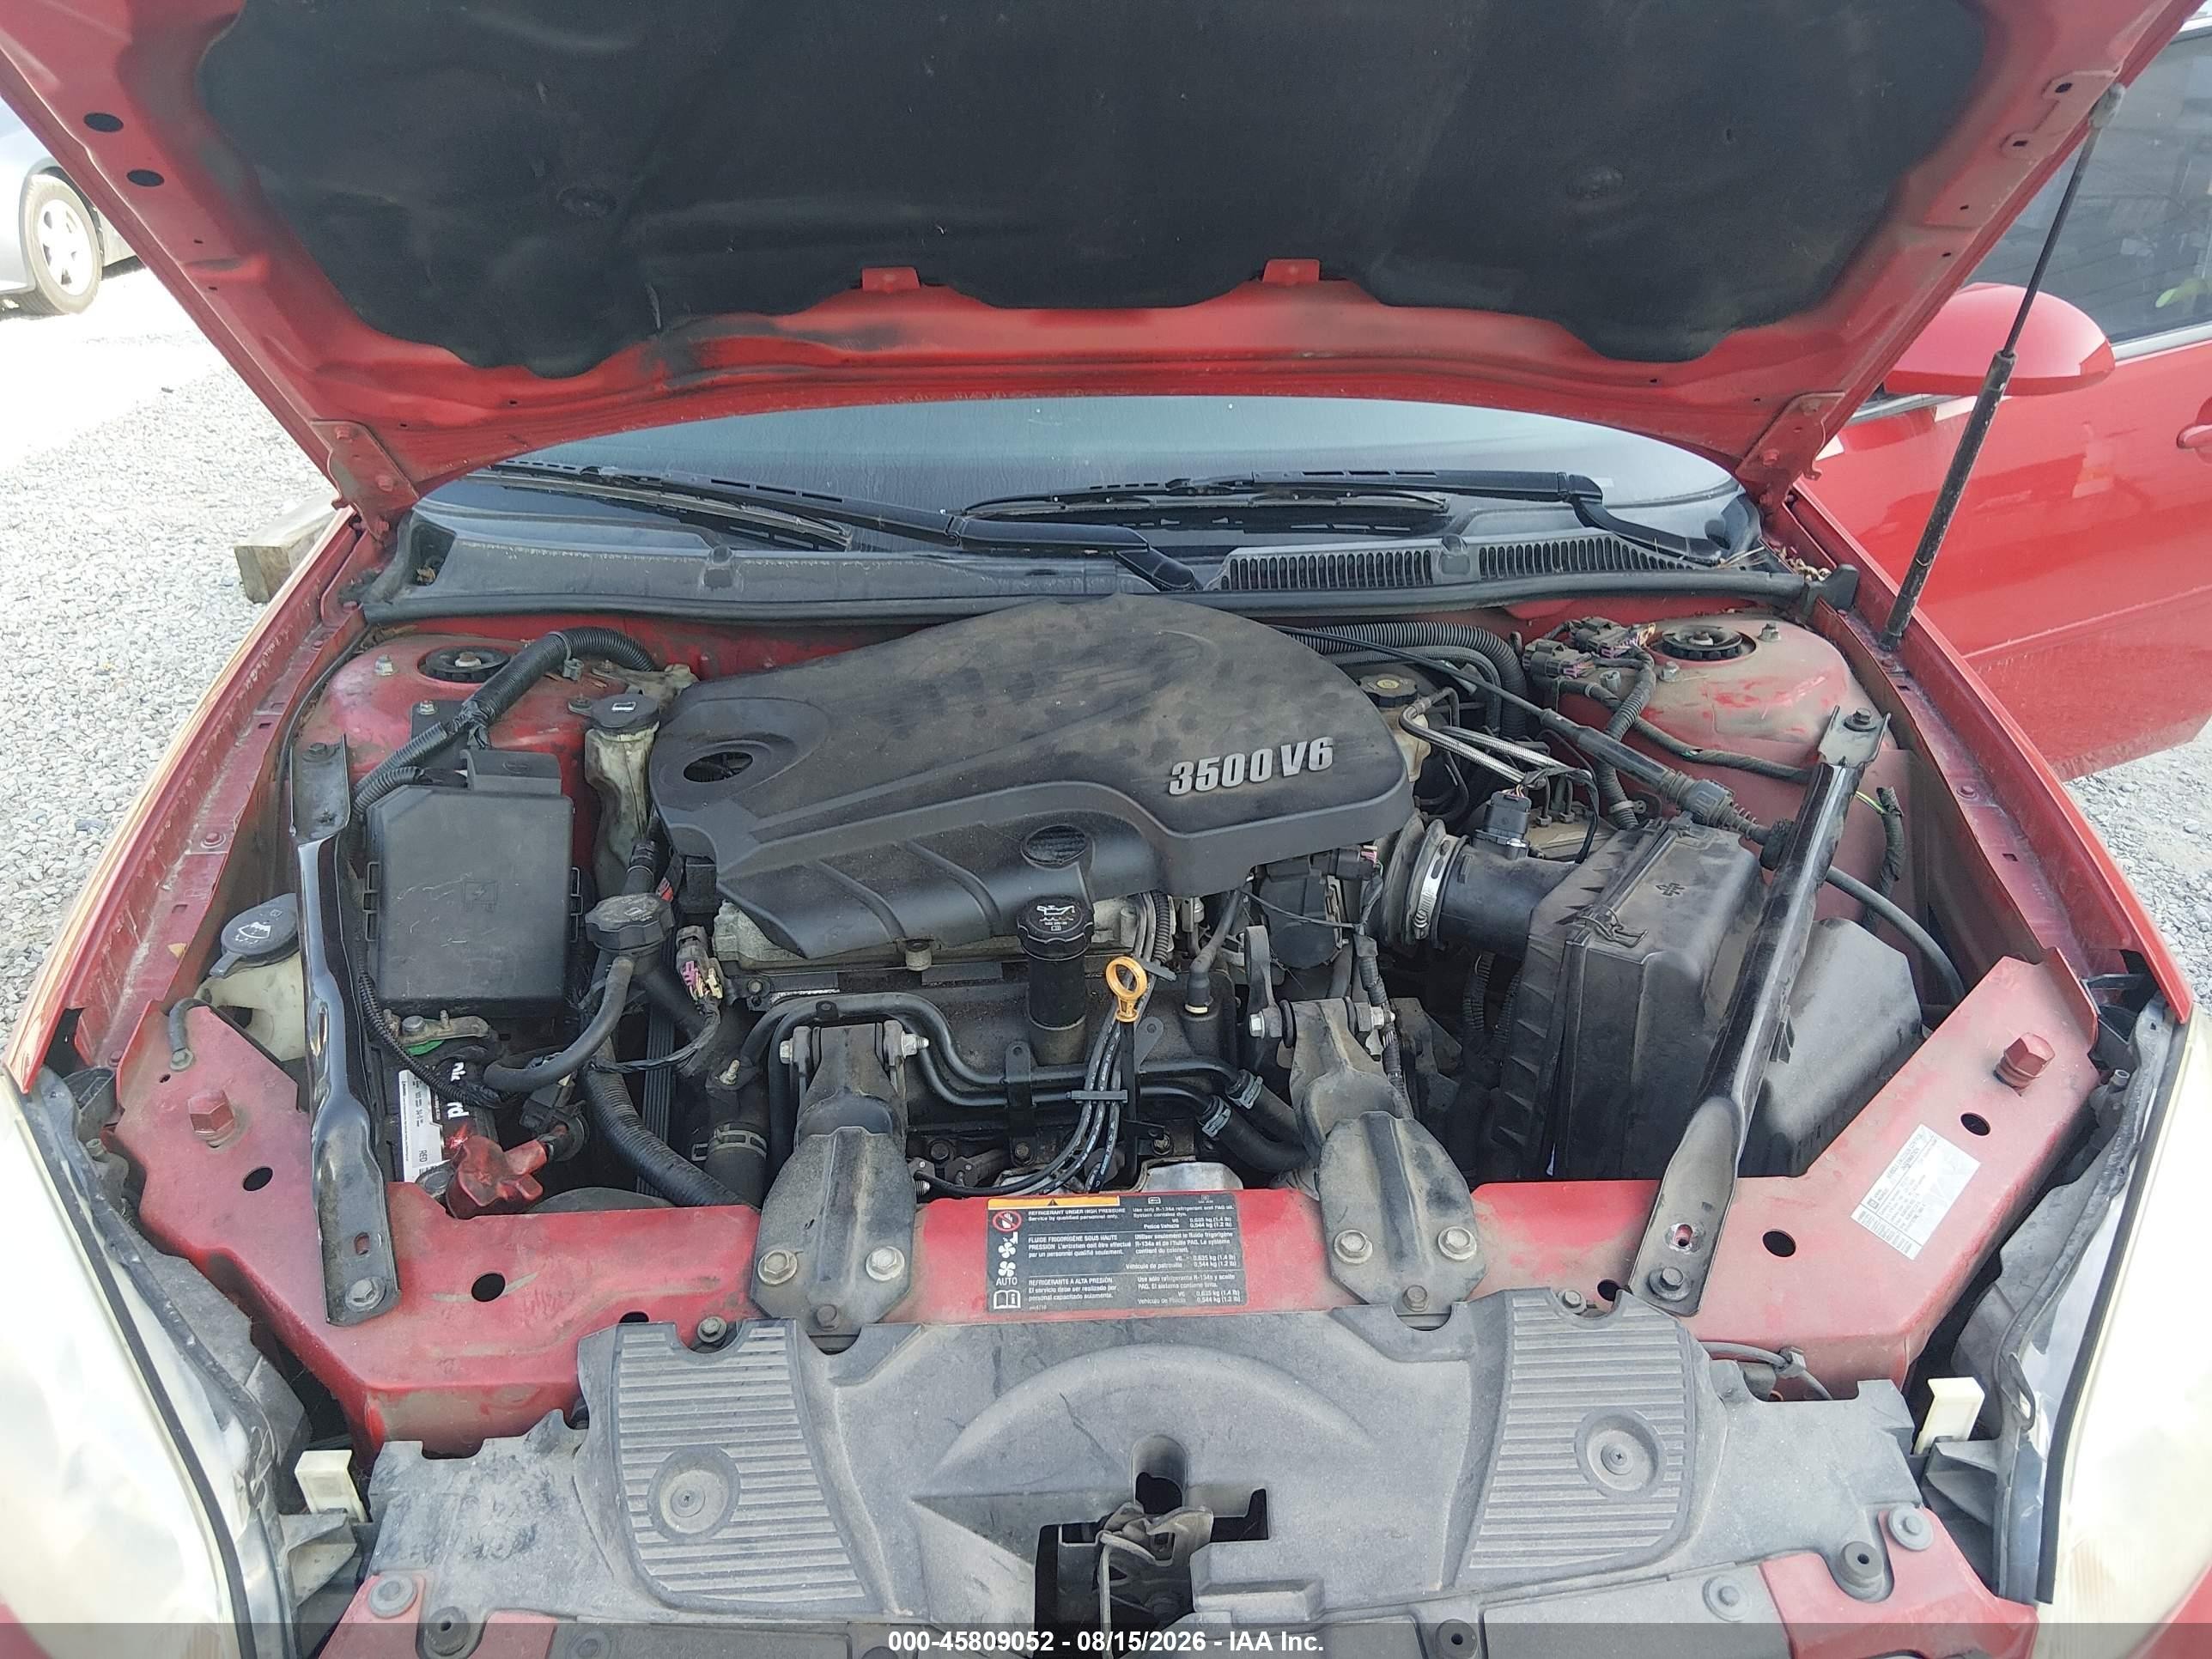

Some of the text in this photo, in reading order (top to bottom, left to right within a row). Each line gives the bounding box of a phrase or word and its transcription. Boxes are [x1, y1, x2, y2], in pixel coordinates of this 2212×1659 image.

[1169, 736, 1333, 796] 3500 V6
[995, 1276, 1018, 1285] AUTO
